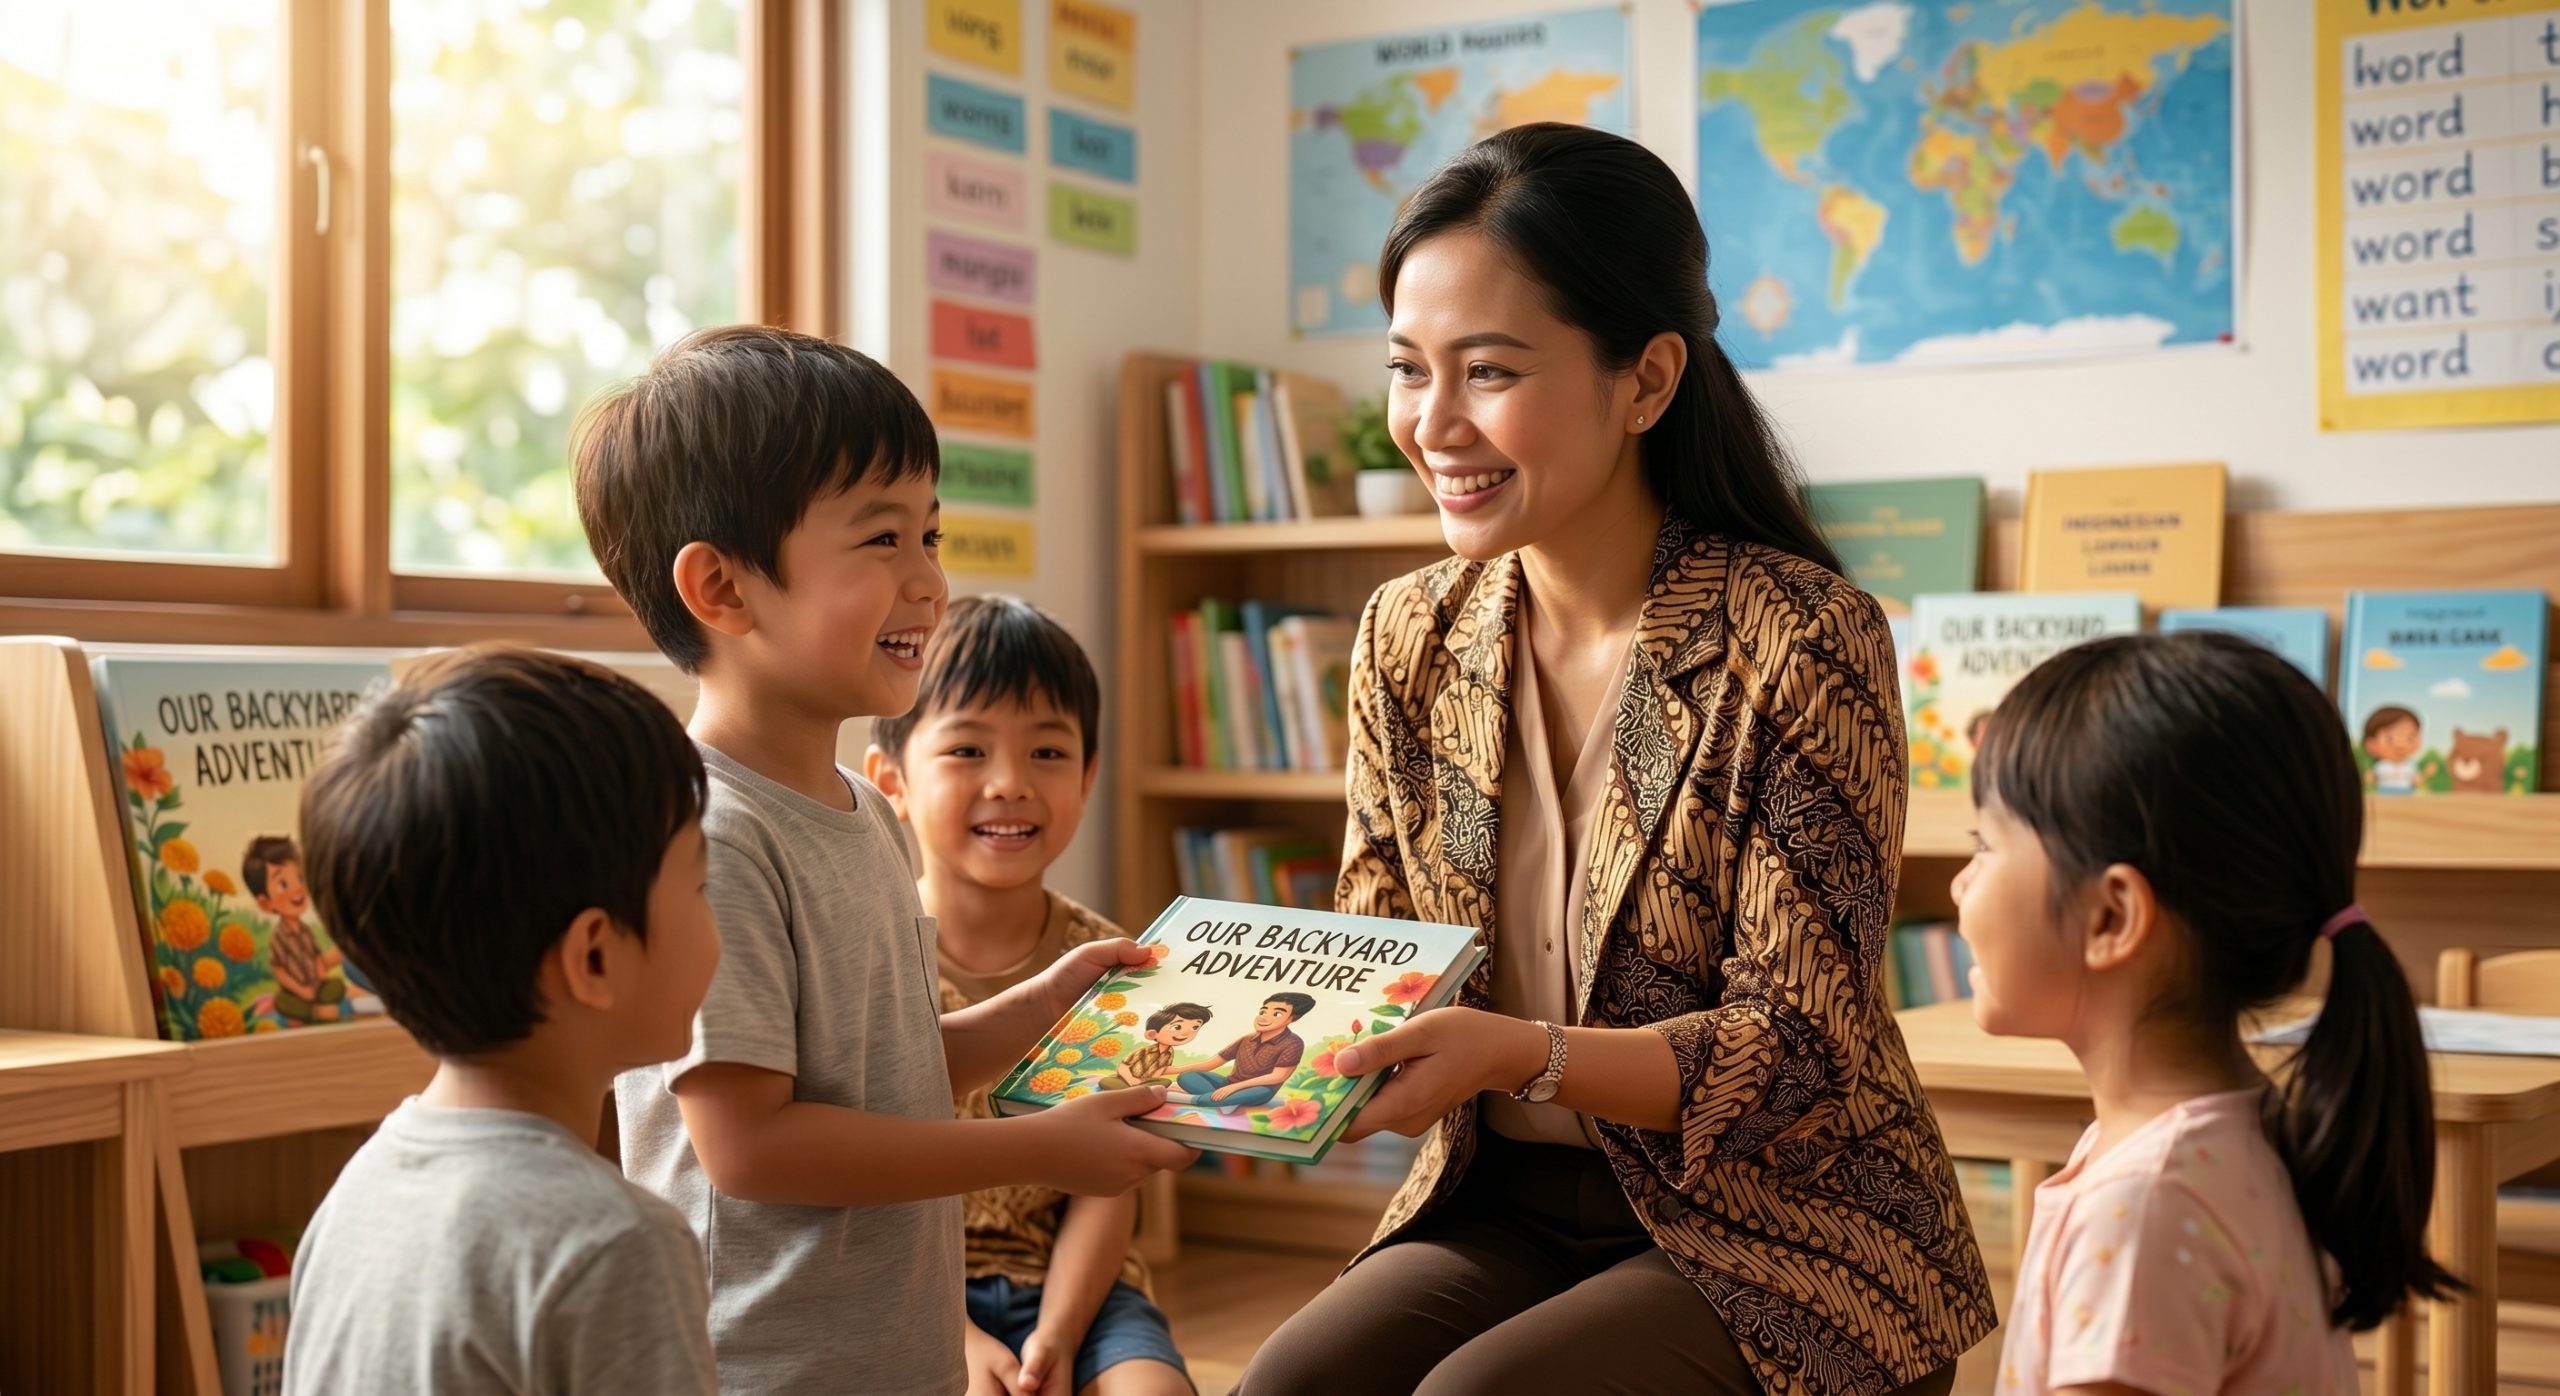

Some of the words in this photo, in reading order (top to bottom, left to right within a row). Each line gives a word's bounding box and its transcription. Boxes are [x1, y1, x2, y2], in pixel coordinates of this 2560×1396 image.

[2351, 93, 2465, 146] word
[2352, 150, 2475, 206] word
[2352, 211, 2476, 264] word
[2352, 273, 2478, 323] want
[2353, 331, 2470, 383] word
[1941, 616, 1984, 643] OUR
[1995, 614, 2106, 641] BACKYARD
[158, 691, 219, 735] OUR
[1186, 920, 1252, 946] OUR
[1255, 924, 1419, 966] BACKYARD
[1181, 950, 1376, 993] ADVENTURE
